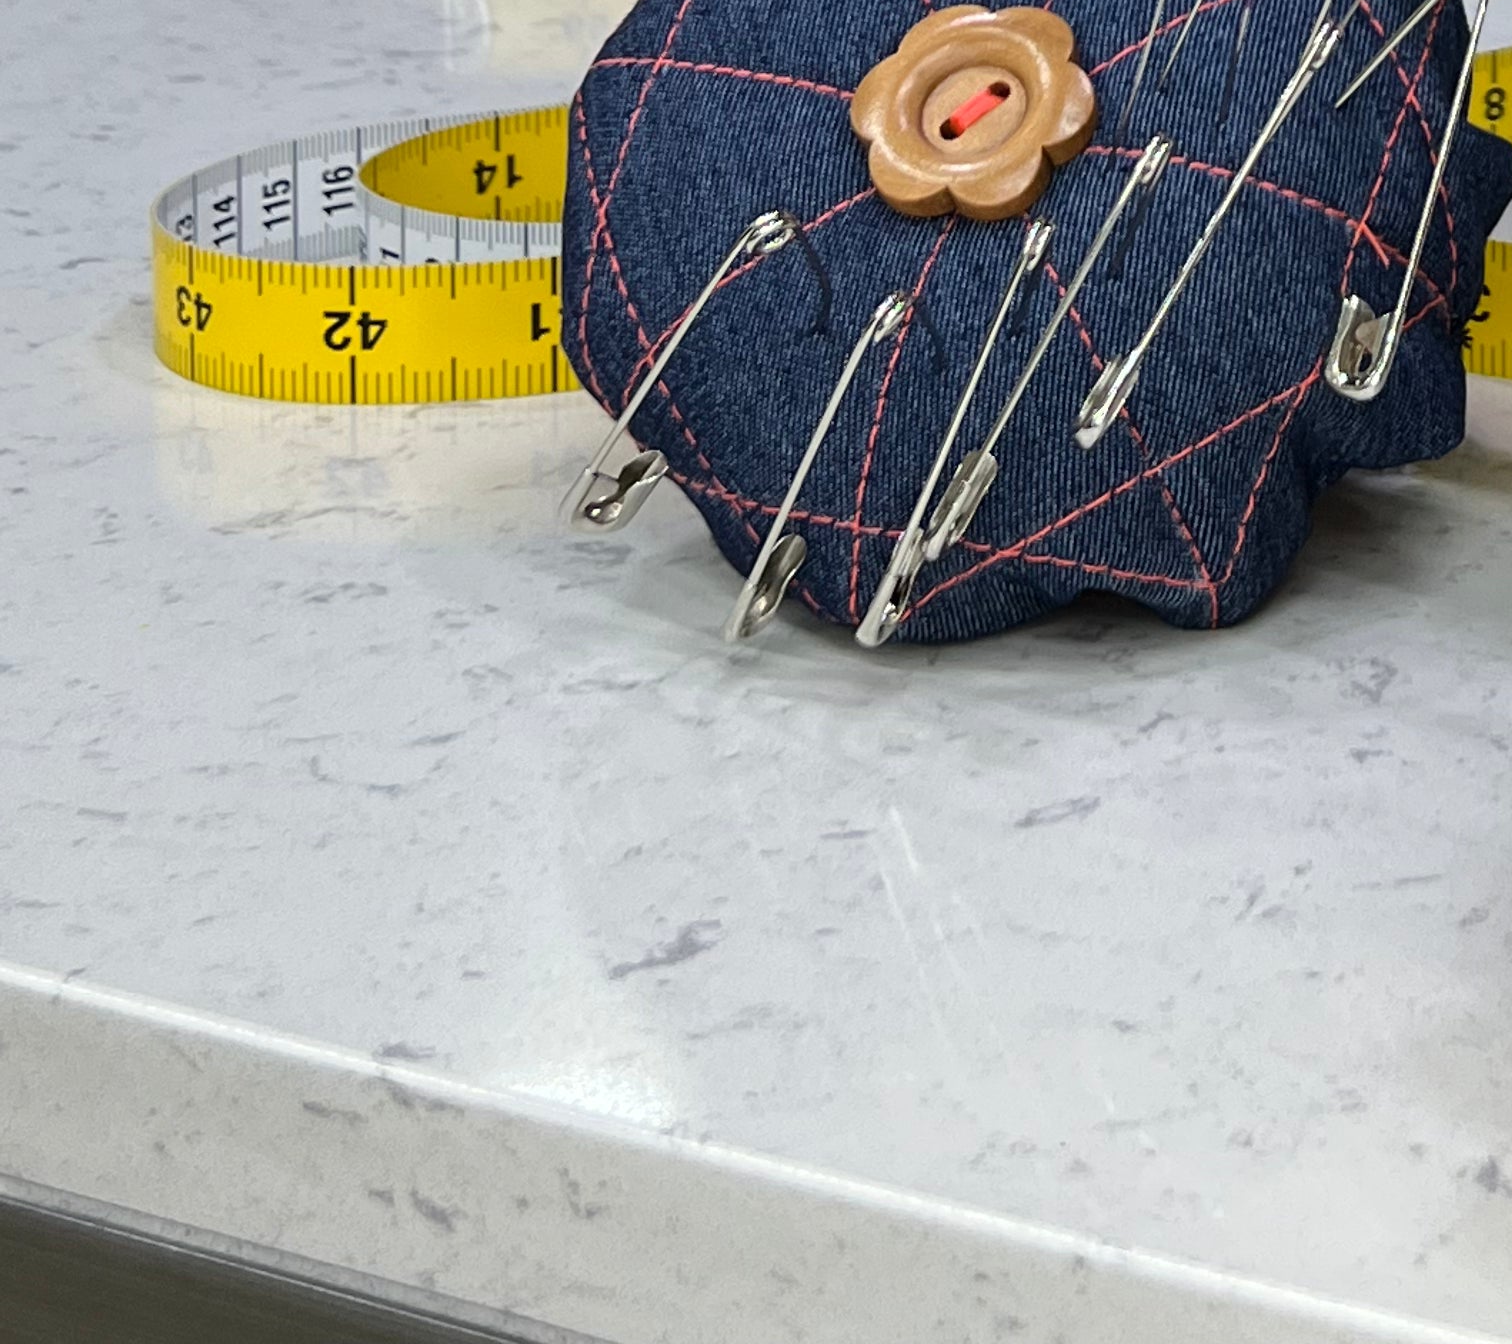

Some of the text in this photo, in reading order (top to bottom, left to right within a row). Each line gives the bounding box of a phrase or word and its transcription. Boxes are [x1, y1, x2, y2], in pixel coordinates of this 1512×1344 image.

[1484, 87, 1506, 121] 8
[474, 154, 523, 195] 14
[212, 195, 236, 249] 114
[262, 178, 291, 232] 115
[322, 165, 355, 216] 116
[175, 285, 562, 351] 43 42 1
